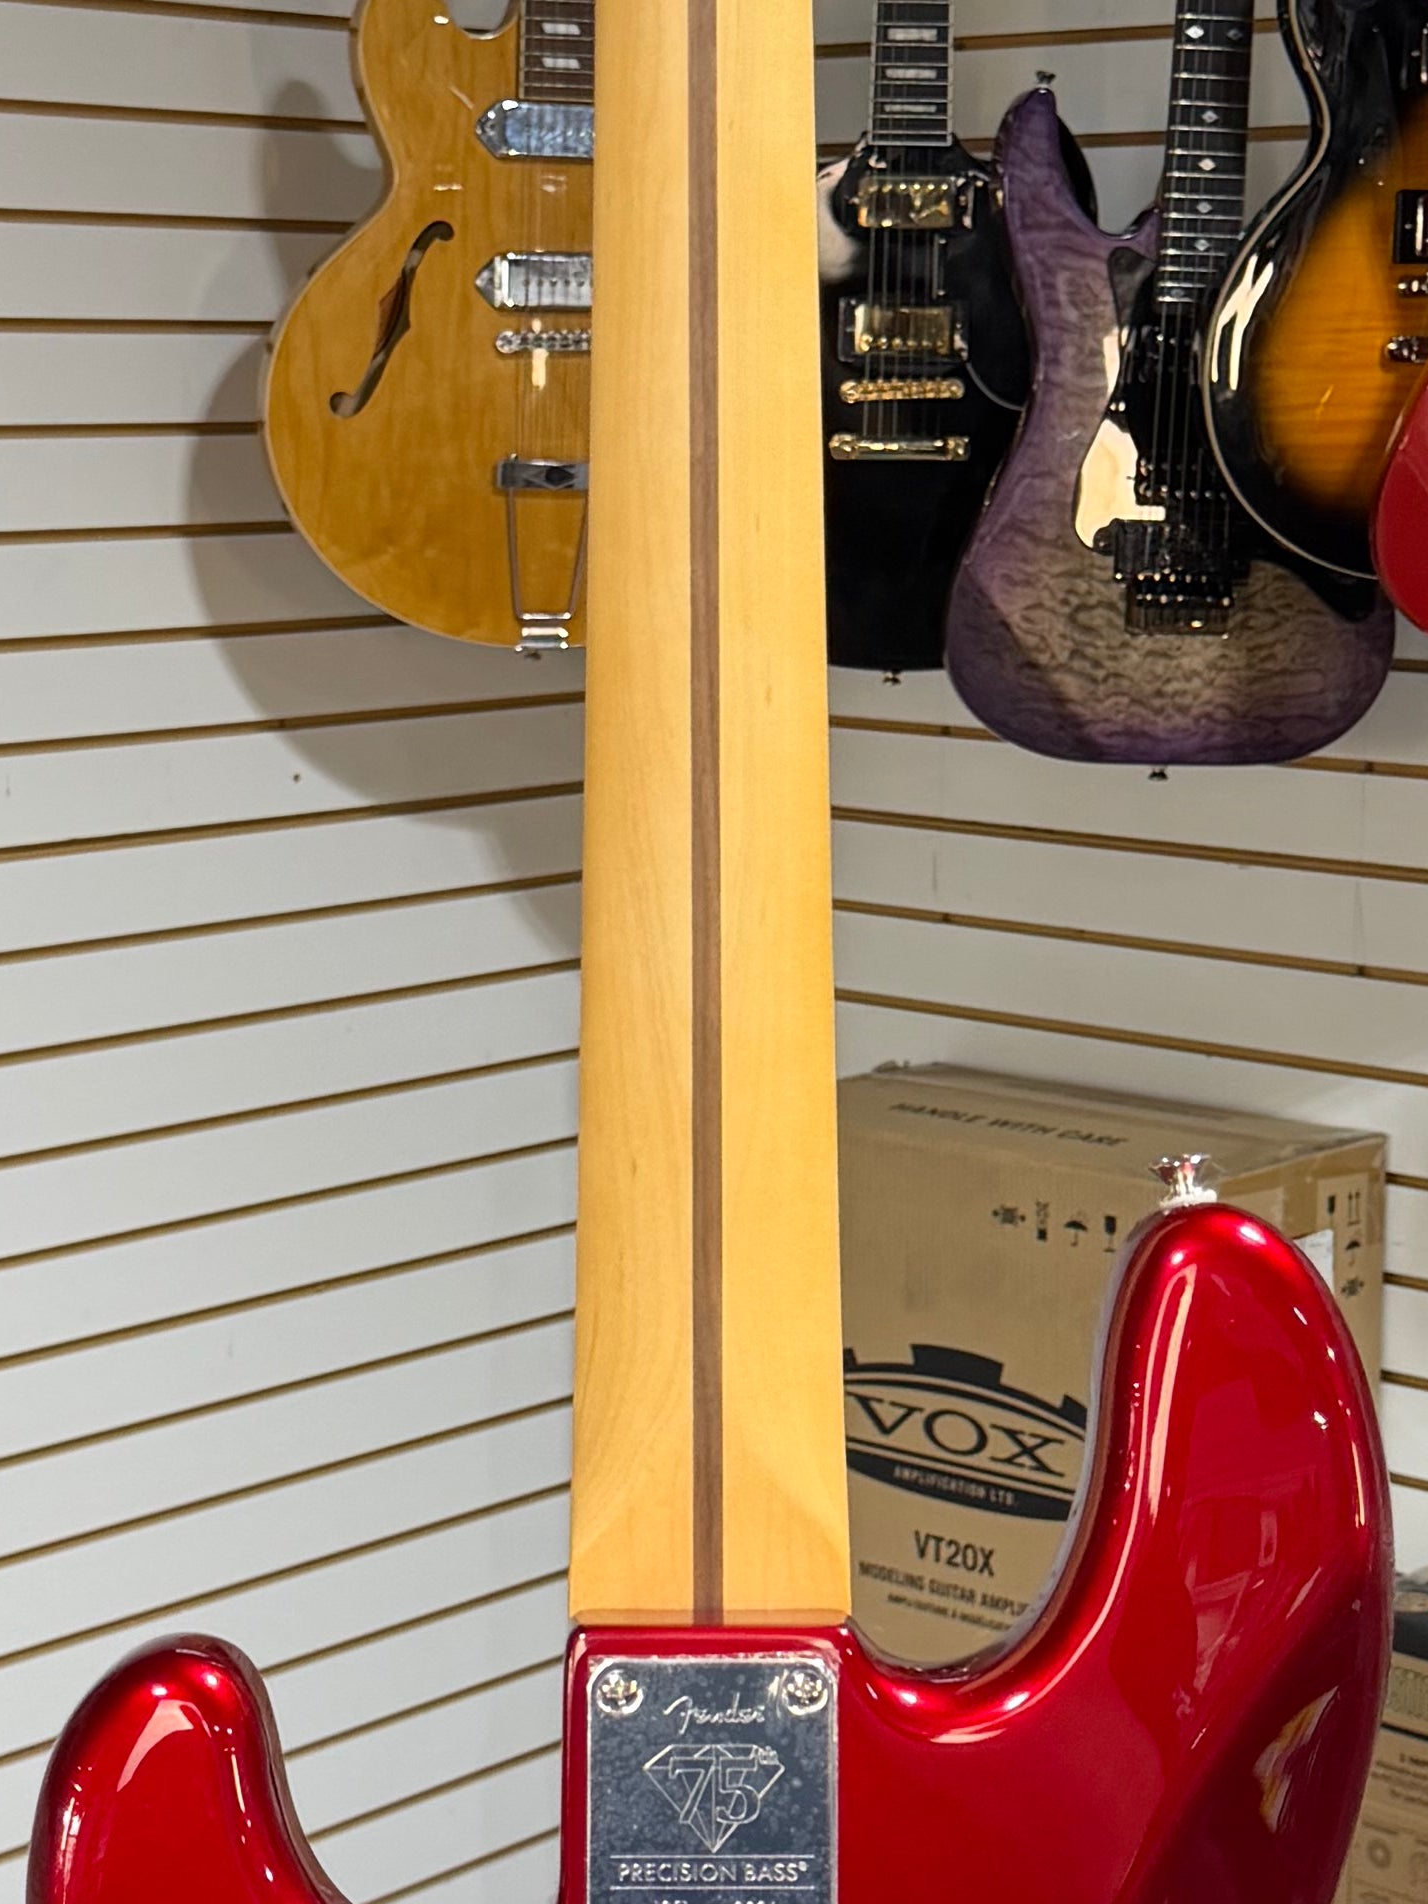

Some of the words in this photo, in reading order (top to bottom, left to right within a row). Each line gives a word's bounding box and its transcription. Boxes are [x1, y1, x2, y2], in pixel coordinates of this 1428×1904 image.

[851, 1396, 1067, 1480] VOX
[914, 1529, 996, 1577] VT20X
[857, 1559, 926, 1592] MODELING
[927, 1577, 977, 1604] GUITAR
[662, 1692, 766, 1735] Fender
[617, 1863, 737, 1883] PRECISION
[744, 1862, 800, 1882] BASS
